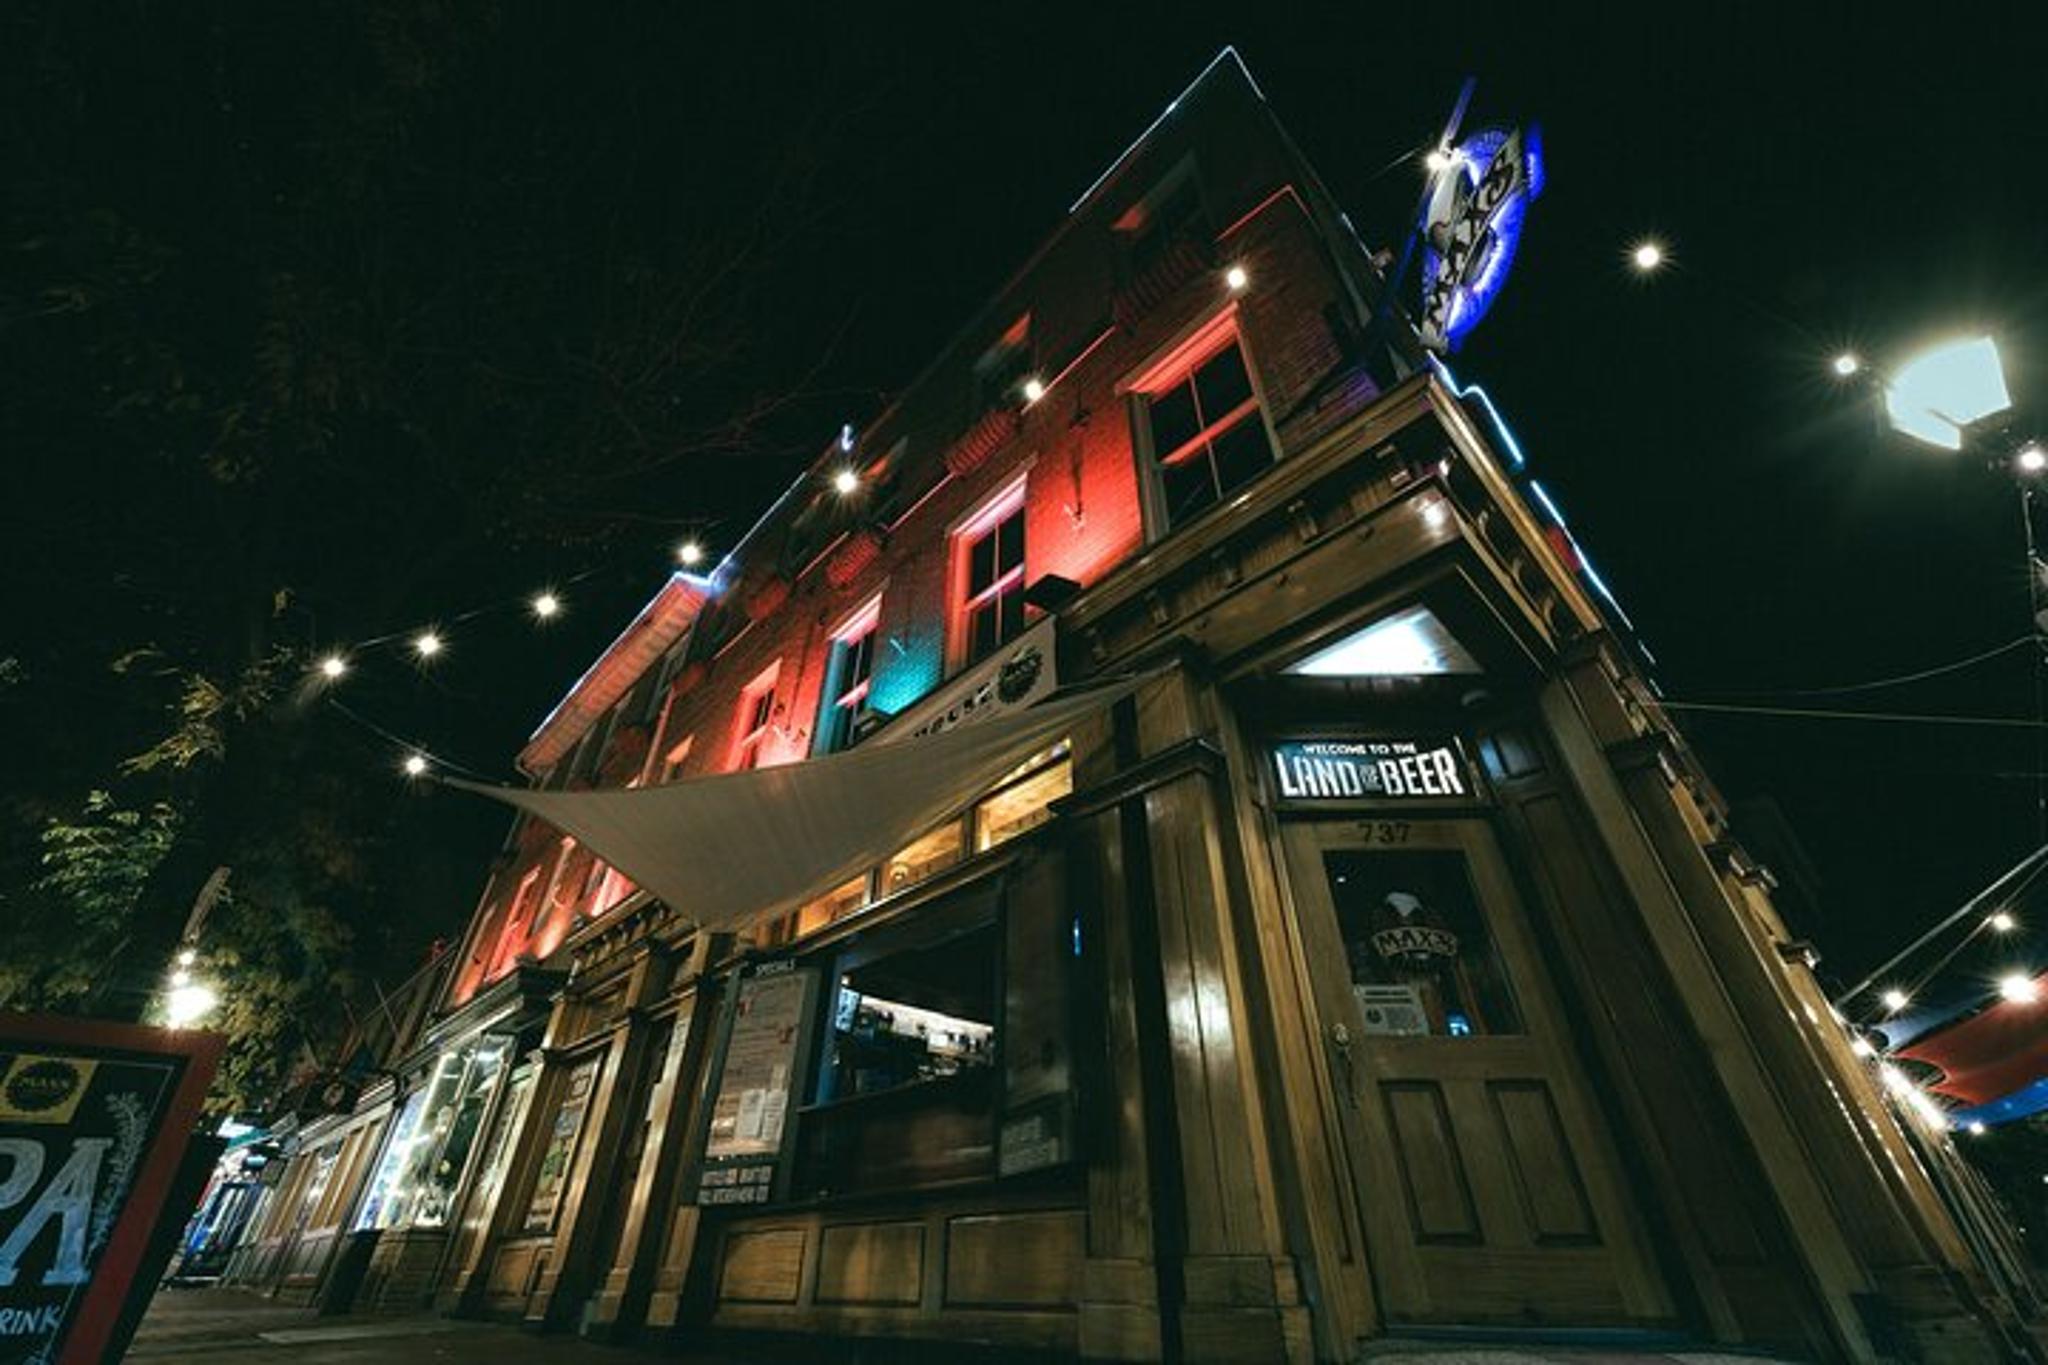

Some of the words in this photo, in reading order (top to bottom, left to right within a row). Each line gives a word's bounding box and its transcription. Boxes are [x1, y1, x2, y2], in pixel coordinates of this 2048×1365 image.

[1301, 743, 1366, 755] WELCOME
[1367, 743, 1390, 755] TO
[1391, 742, 1417, 755] THE
[1275, 752, 1363, 797] LAND
[1377, 747, 1465, 795] BEER
[1357, 822, 1413, 844] 737
